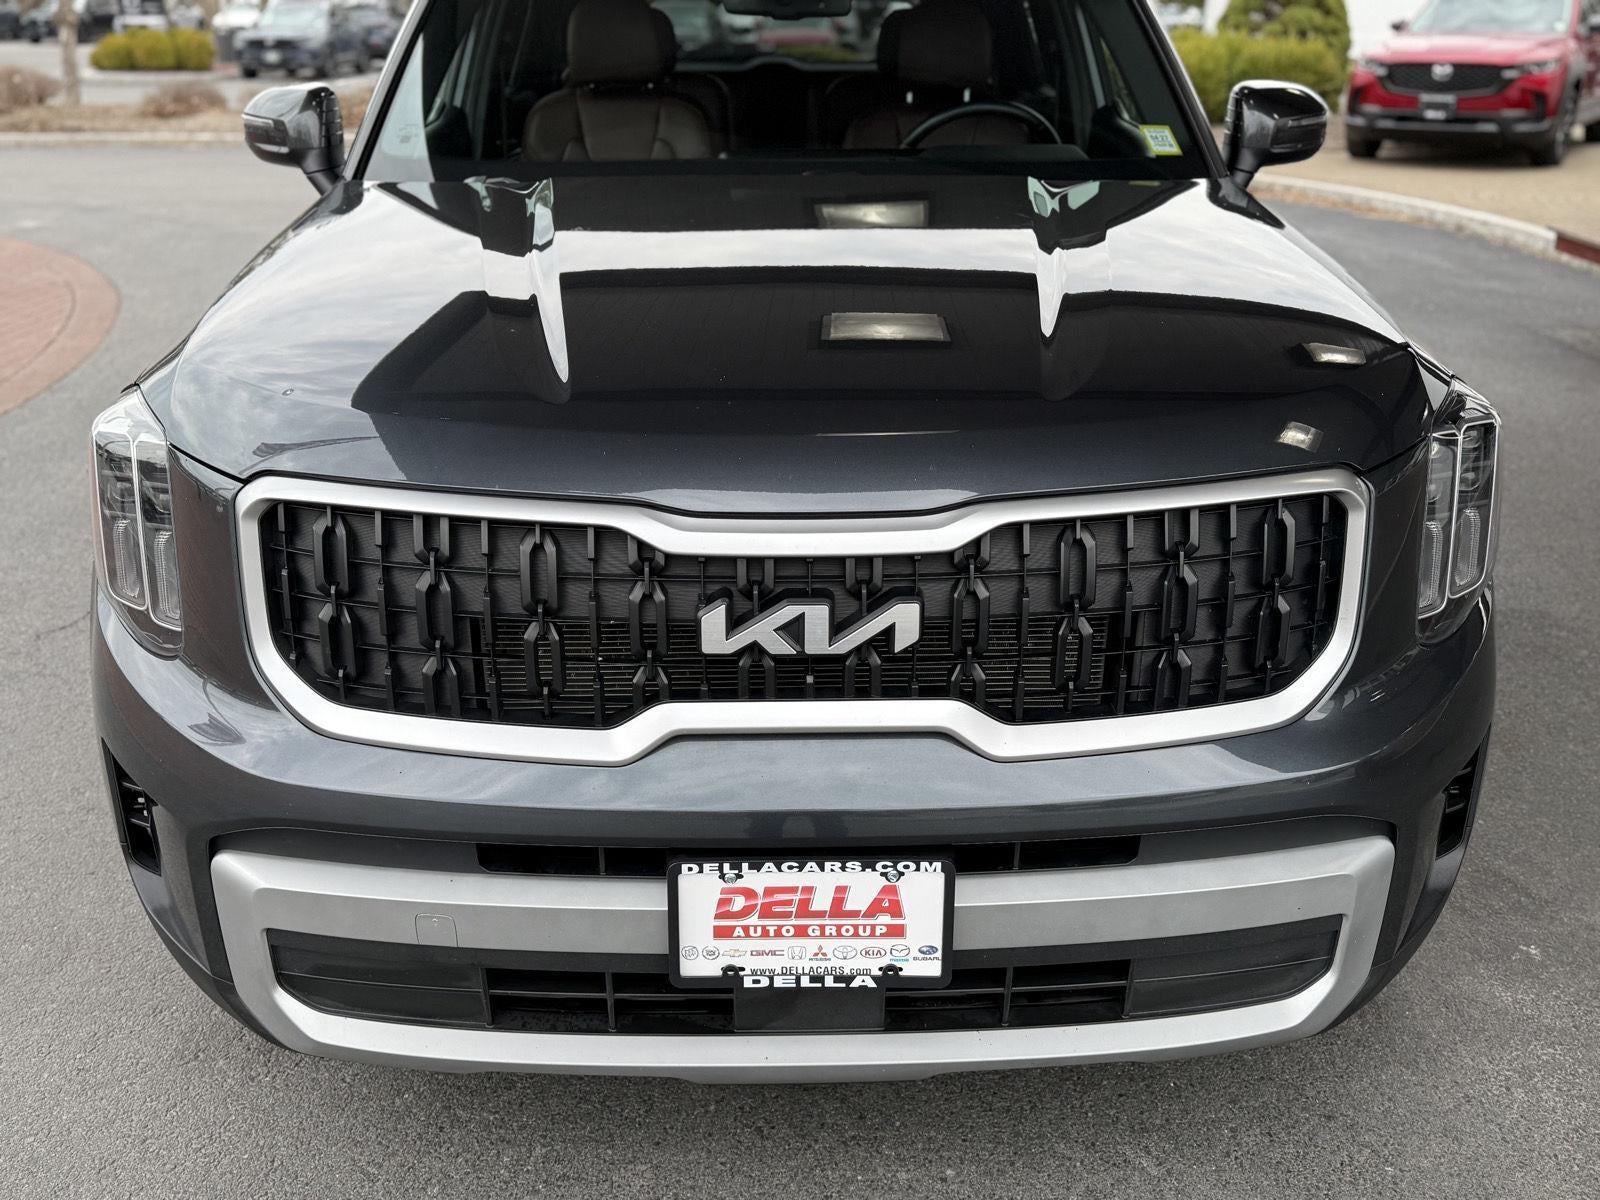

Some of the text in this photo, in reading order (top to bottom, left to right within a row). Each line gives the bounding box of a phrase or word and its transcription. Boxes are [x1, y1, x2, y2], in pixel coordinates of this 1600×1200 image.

[699, 600, 921, 655] KIA
[681, 861, 942, 874] DELLACARS.COM
[713, 884, 905, 920] DELLA
[732, 925, 888, 937] AUTO GROUP
[750, 949, 785, 957] GMC
[750, 965, 872, 976] www.DELLACARS.com
[743, 975, 878, 988] DELLA
